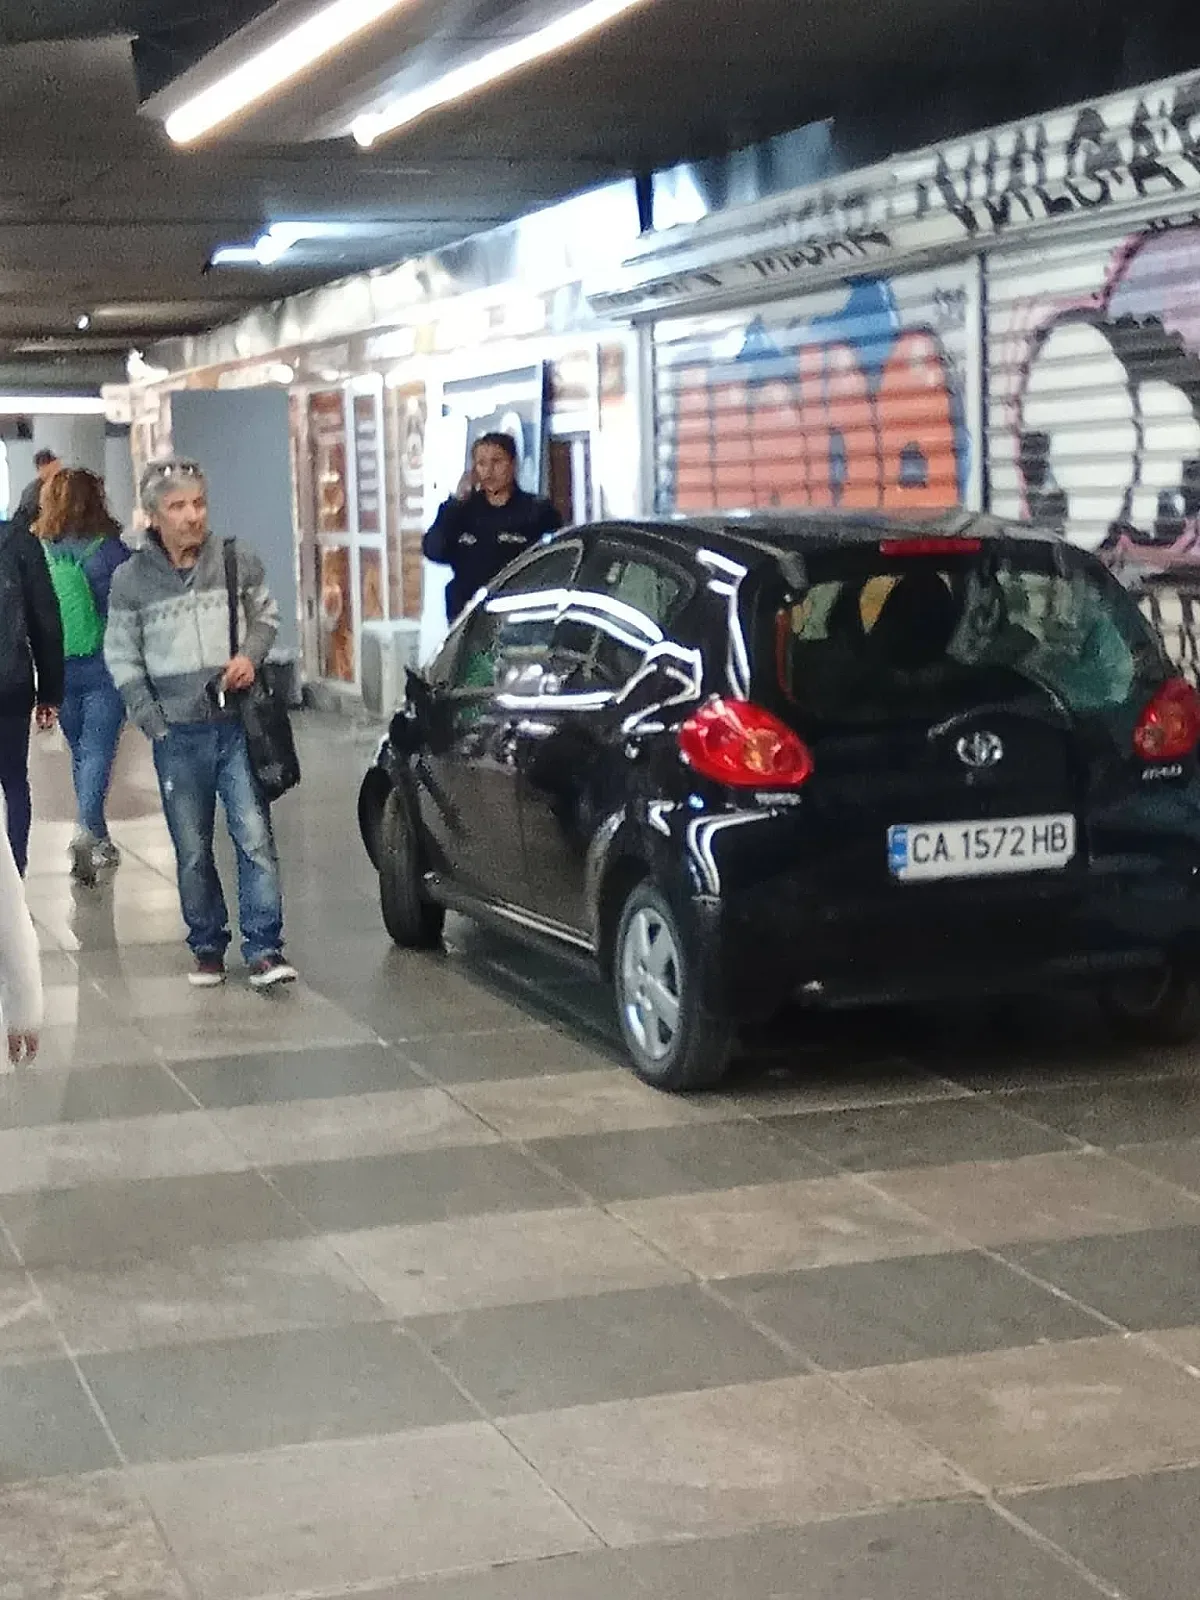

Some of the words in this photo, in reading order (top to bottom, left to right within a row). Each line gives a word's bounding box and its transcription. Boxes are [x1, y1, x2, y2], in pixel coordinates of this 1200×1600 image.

[912, 832, 950, 863] CA
[961, 826, 1025, 860] 1572
[1031, 822, 1067, 854] HB
